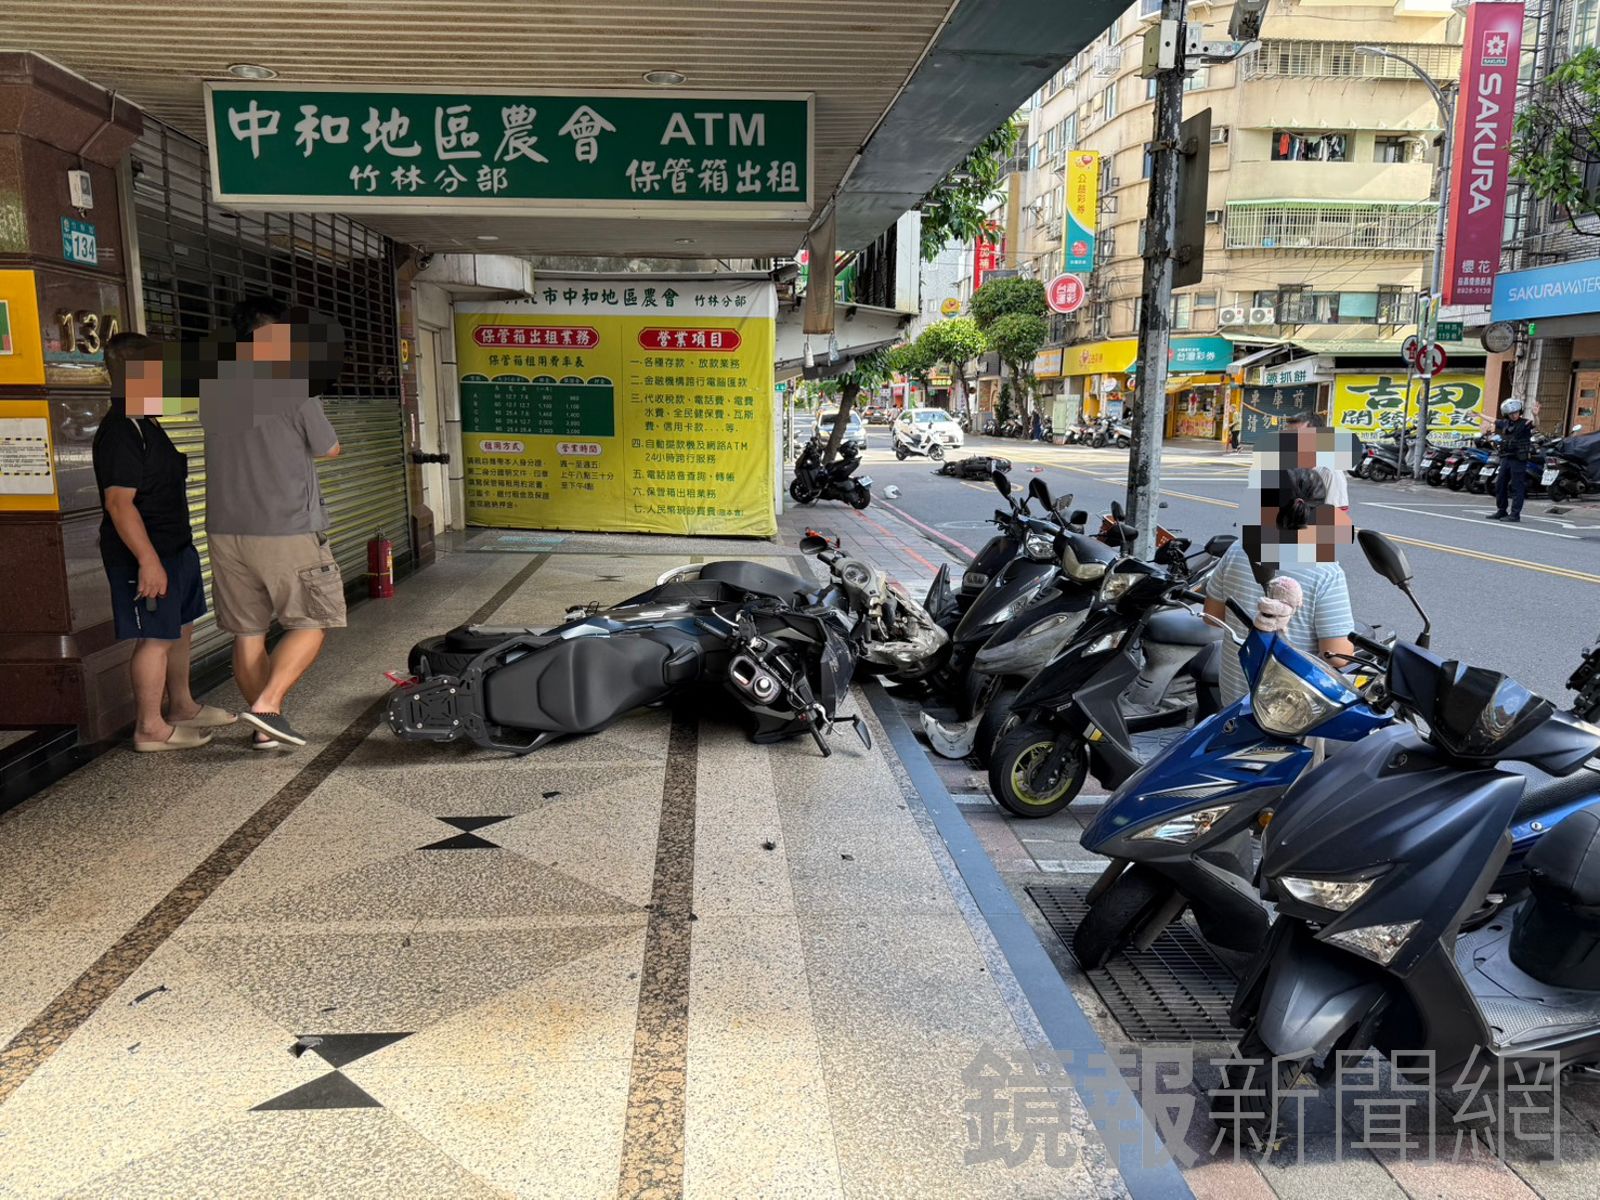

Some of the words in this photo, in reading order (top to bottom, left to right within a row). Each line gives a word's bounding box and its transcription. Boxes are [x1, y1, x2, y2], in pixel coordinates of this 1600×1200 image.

[228, 100, 616, 165] 中和地區農會
[660, 112, 766, 147] ATM
[1468, 72, 1502, 215] SAKURA
[350, 165, 509, 193] 竹林分部
[626, 158, 800, 195] 保管箱出租
[74, 235, 95, 260] 134
[1462, 259, 1491, 274] 櫻花
[504, 287, 679, 307] 市中和地區農會
[694, 294, 747, 308] 竹林分部
[481, 328, 591, 345] 保管箱出租業務
[657, 330, 722, 348] 營業項目
